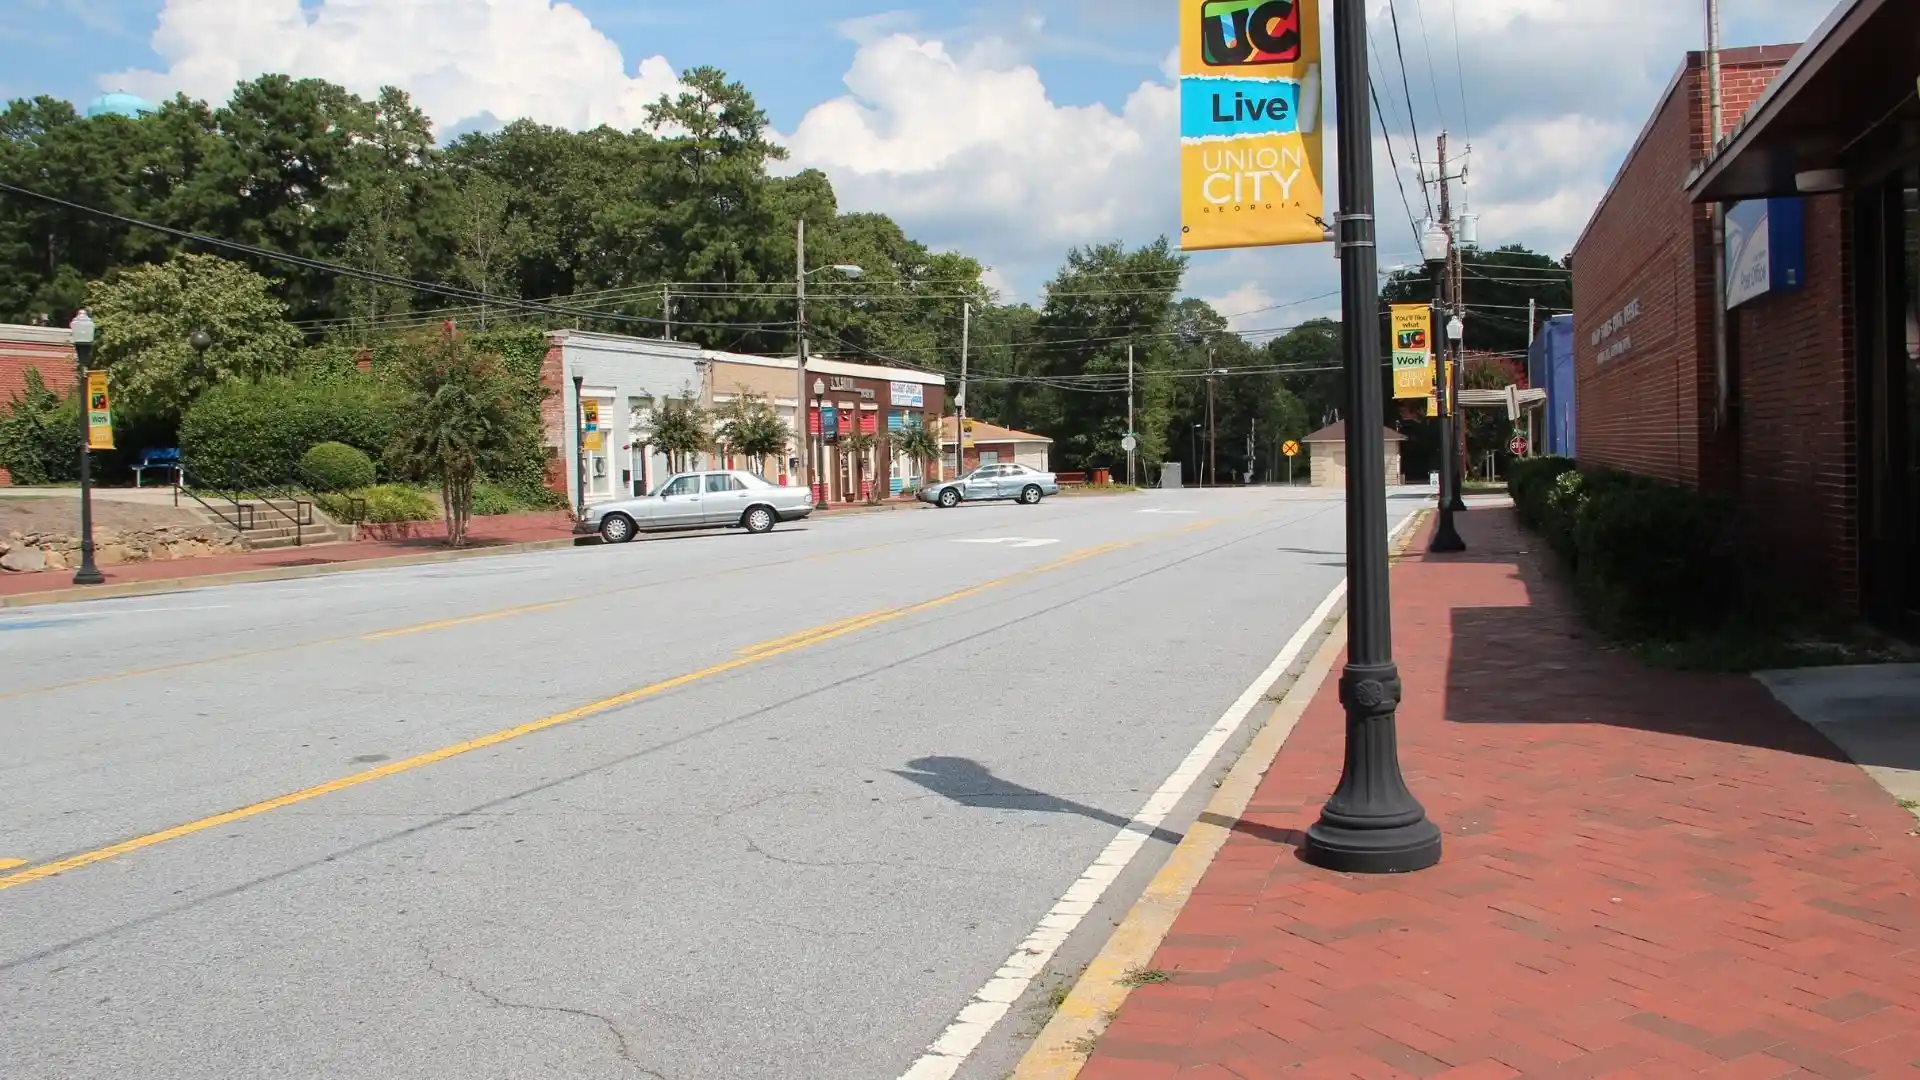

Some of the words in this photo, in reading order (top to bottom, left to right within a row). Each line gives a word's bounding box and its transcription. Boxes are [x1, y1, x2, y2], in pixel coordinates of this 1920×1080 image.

[1204, 0, 1299, 62] UC
[1212, 92, 1289, 122] Live
[1203, 147, 1301, 172] UNION
[1203, 169, 1300, 204] CITY
[1203, 201, 1300, 213] GEORGIA
[1396, 355, 1425, 365] Work
